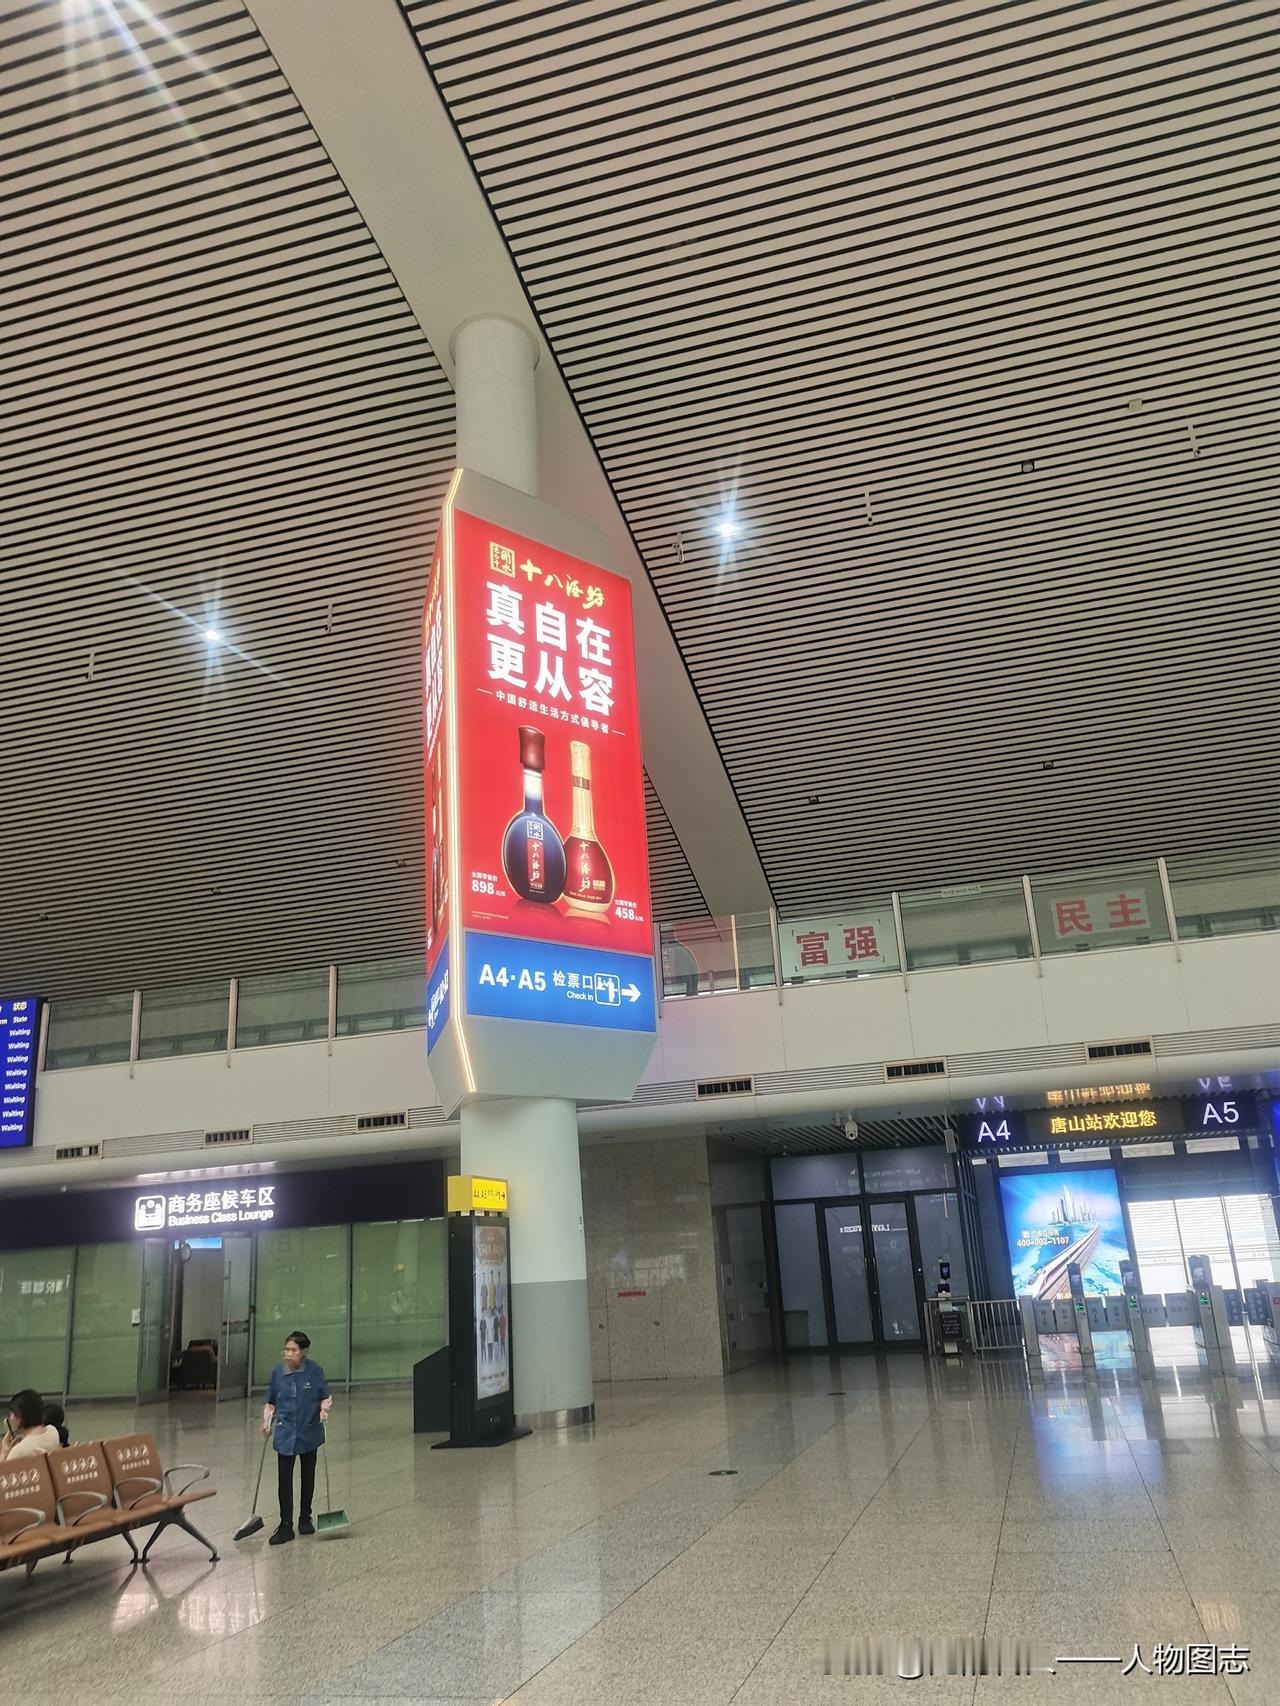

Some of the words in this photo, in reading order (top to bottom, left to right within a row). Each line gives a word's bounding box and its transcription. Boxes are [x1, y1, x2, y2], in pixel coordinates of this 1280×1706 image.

[486, 581, 612, 666] 真自在
[487, 634, 615, 717] 更从容
[496, 690, 609, 734] 中国舒适生活方式倡导者
[471, 879, 495, 895] 898
[615, 906, 635, 920] 458
[1055, 893, 1147, 935] 民主
[795, 926, 881, 967] 富强
[552, 969, 593, 990] 检票口
[566, 990, 586, 1000] Check
[13, 1016, 28, 1024] State
[9, 1028, 31, 1037] Waiting
[8, 1042, 30, 1050] Waiting
[7, 1055, 29, 1063] Waiting
[6, 1069, 28, 1077] Waiting
[4, 1082, 27, 1090] Waiting
[3, 1096, 26, 1104] Waiting
[2, 1109, 25, 1118] Waiting
[1202, 1101, 1240, 1125] A5
[1, 1123, 24, 1132] Waiting
[1050, 1109, 1158, 1134] 唐山站欢迎您
[977, 1119, 1011, 1143] A4
[168, 1186, 275, 1214] 商务座候车区
[168, 1213, 210, 1227] Business
[210, 1211, 238, 1224] Class
[238, 1209, 274, 1222] Lounge
